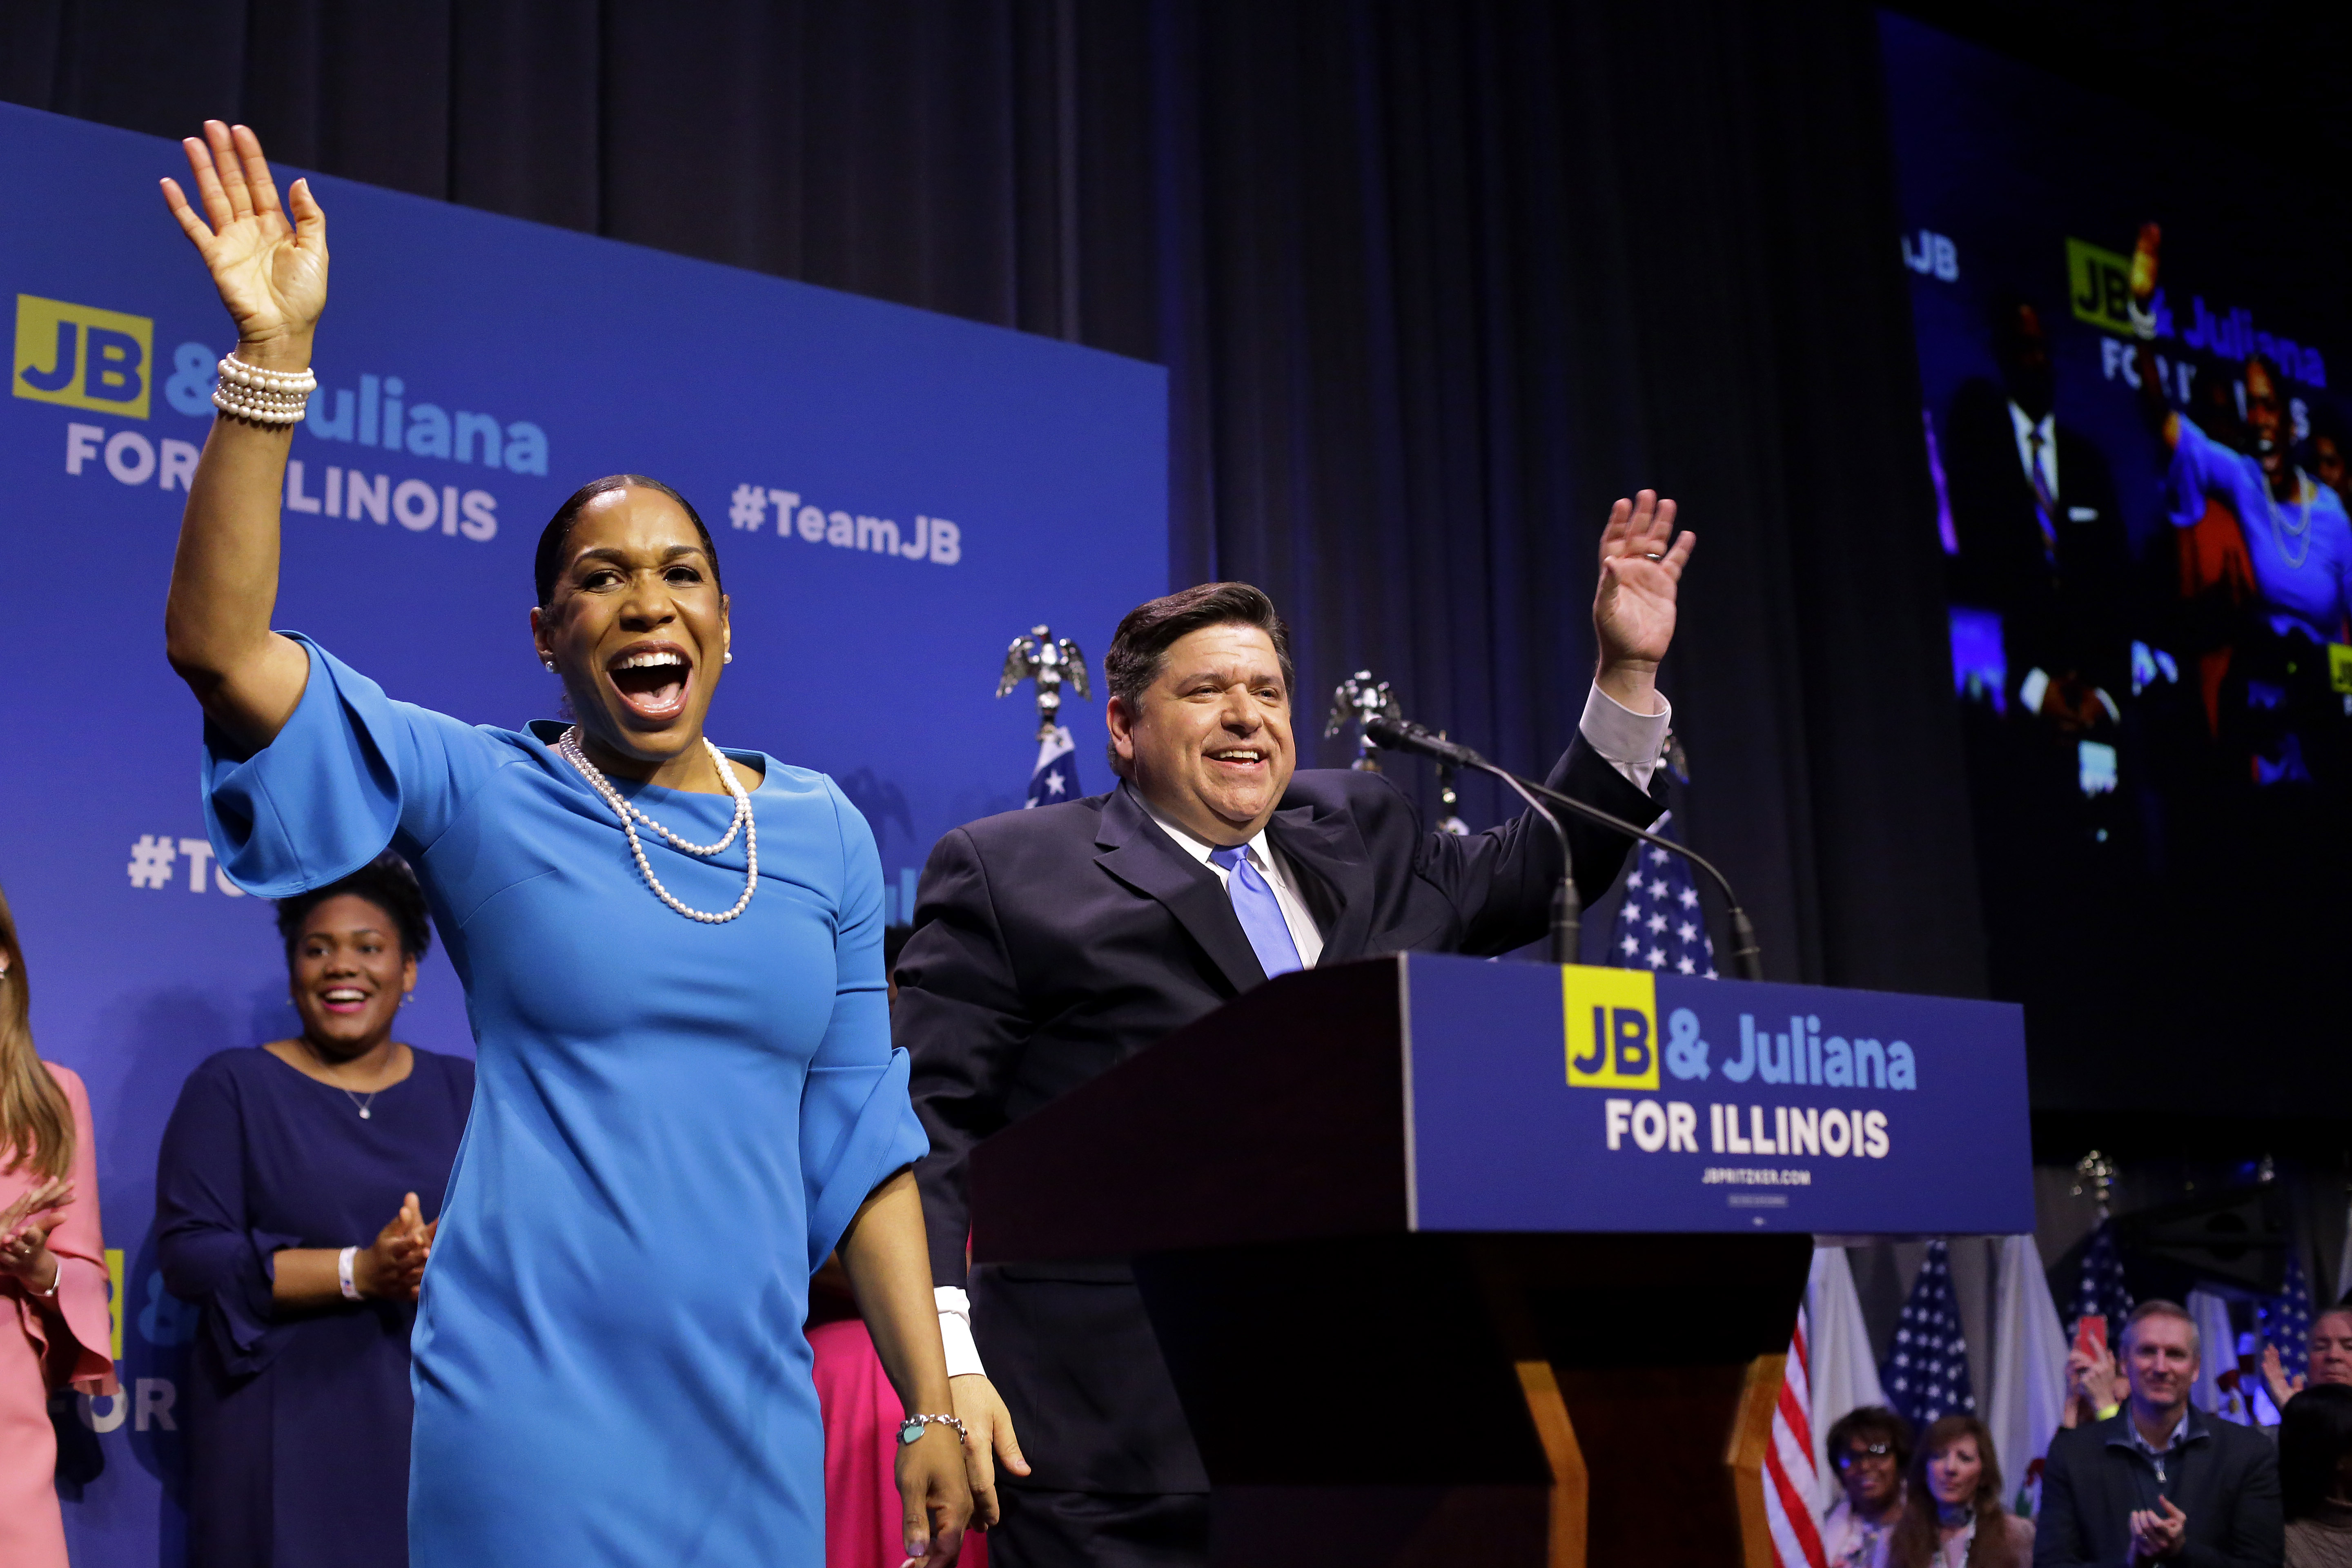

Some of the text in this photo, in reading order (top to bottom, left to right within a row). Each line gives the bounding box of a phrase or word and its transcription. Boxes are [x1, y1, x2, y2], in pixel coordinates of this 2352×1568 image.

[2078, 254, 2131, 318] JB
[20, 320, 549, 477] JB & uliana
[66, 422, 498, 541] FOR LINOIS
[729, 483, 961, 565] #TeamJB
[1572, 1005, 1917, 1091] JB & Juliana
[1605, 1099, 1890, 1159] FOR ILLINOIS
[1702, 1167, 1811, 1185] JBPRITZKER.COM
